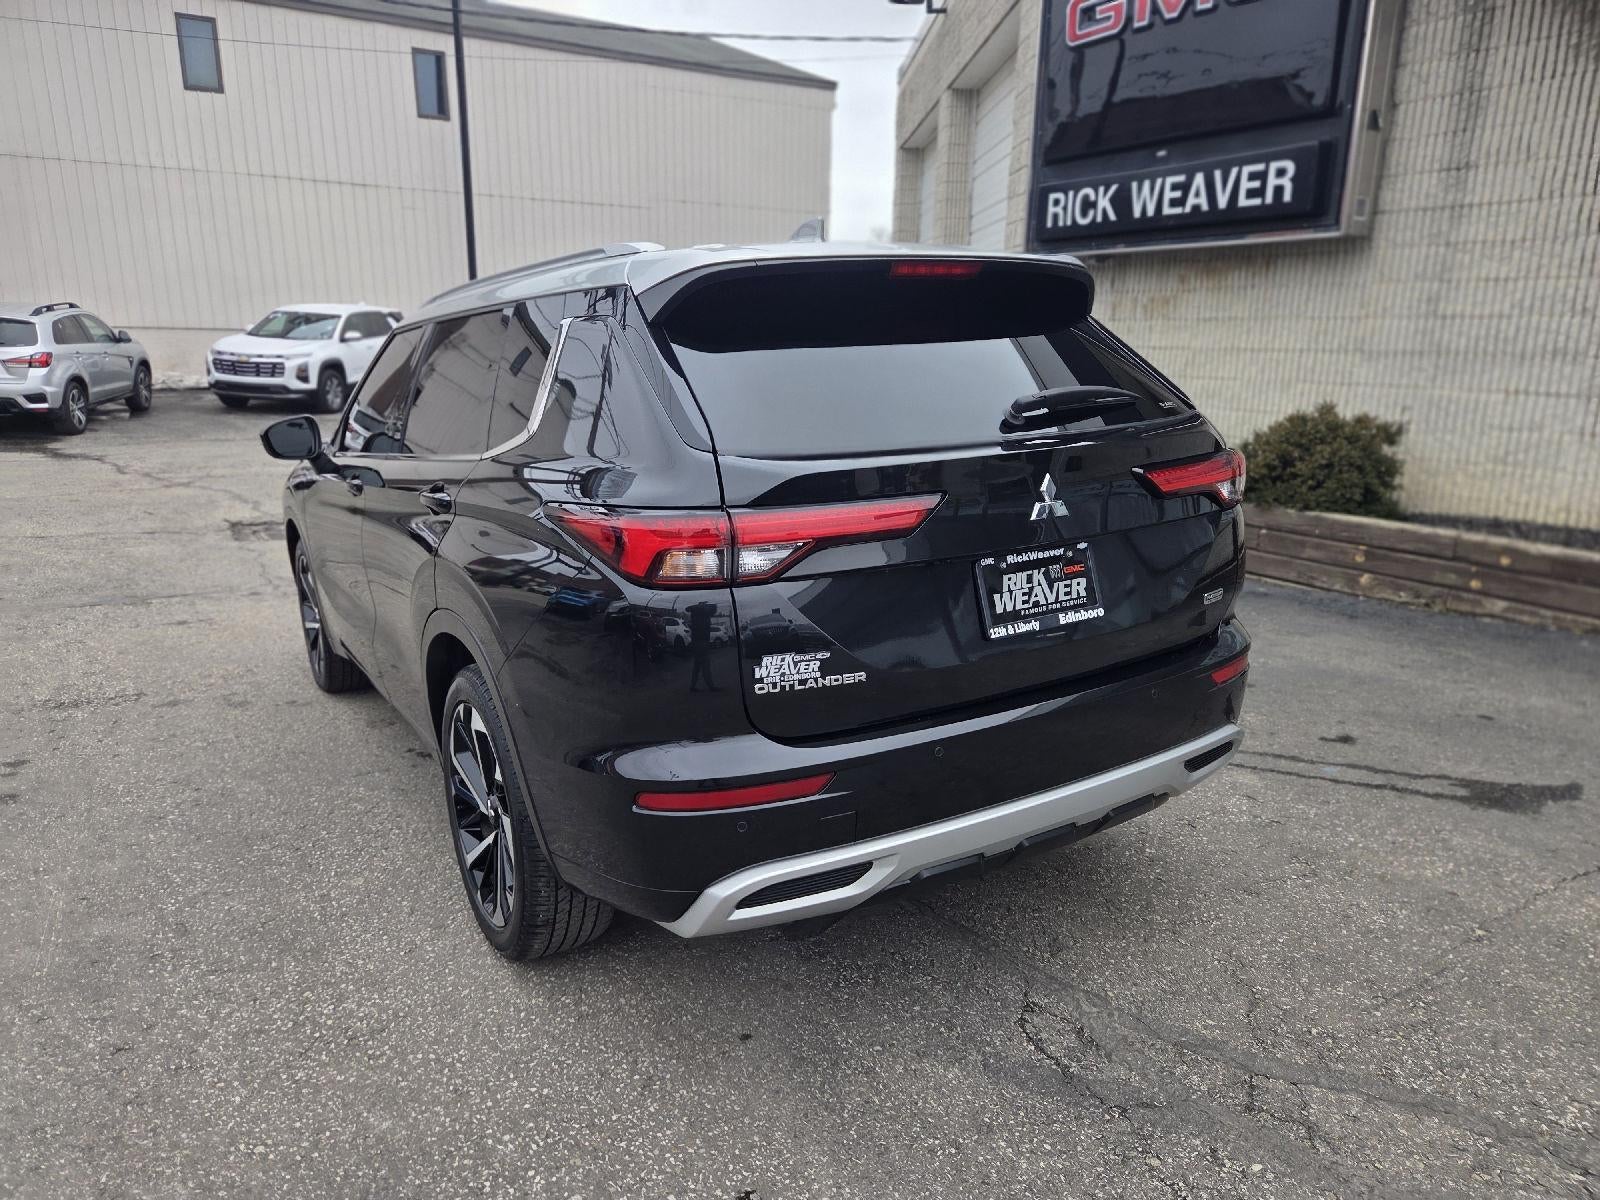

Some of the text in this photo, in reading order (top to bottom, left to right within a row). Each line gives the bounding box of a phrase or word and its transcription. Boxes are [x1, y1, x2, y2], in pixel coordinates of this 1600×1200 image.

[1046, 159, 1297, 229] RICK WEAVER
[1006, 547, 1065, 565] RickWeaver
[1063, 563, 1086, 575] GMC
[1002, 567, 1048, 593] RICK
[993, 577, 1087, 614] WEAVER
[1021, 605, 1047, 616] FAMOUS
[1062, 597, 1088, 608] SERVICE
[1058, 607, 1105, 625] Edinboro
[989, 620, 1040, 639] 12th & Liberty
[761, 652, 816, 667] RICK GMC
[753, 660, 821, 679] WEAVER
[753, 671, 867, 695] OUTLANDER
